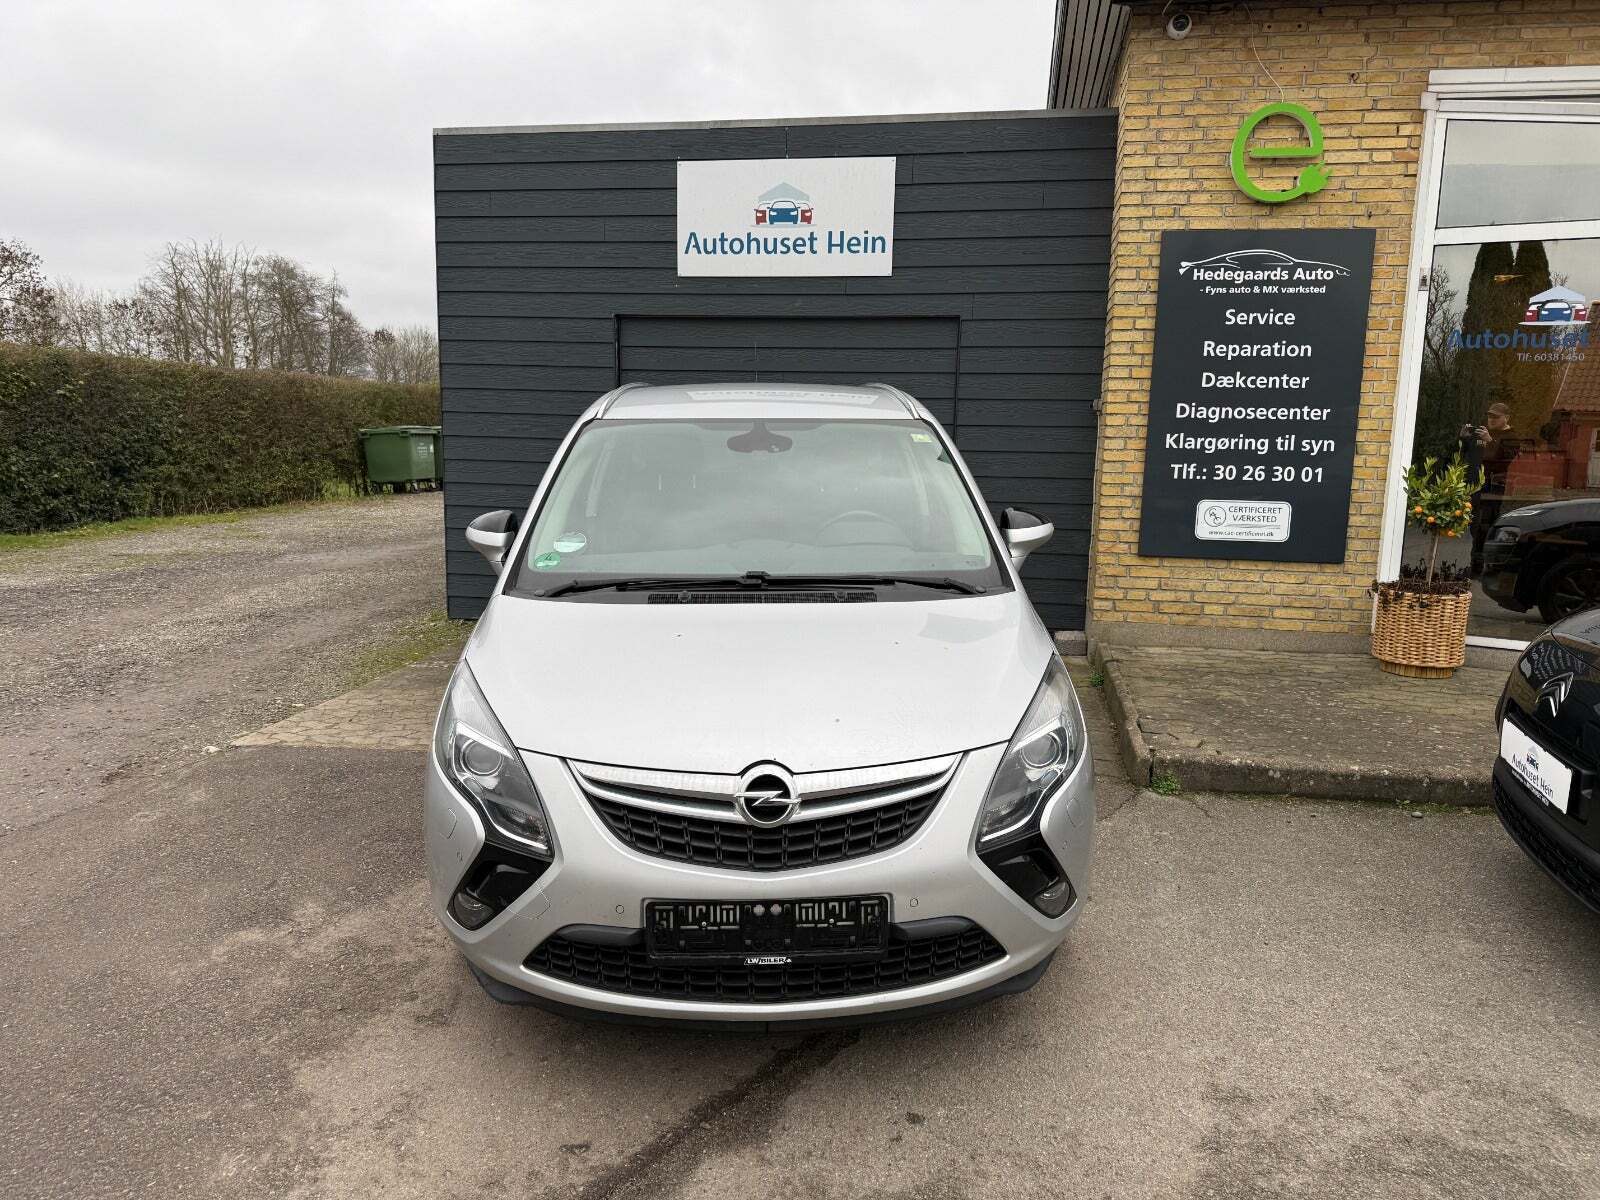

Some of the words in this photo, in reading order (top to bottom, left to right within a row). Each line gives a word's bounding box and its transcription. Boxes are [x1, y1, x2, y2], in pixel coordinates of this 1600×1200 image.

[684, 231, 818, 255] Autohuset
[827, 230, 886, 254] Hein
[1193, 267, 1289, 283] Hedegaards
[1293, 268, 1334, 281] Auto
[1205, 286, 1227, 295] Fyns
[1253, 286, 1261, 294] &
[1263, 286, 1279, 294] MX
[1281, 286, 1326, 294] værksted
[1225, 308, 1296, 326] Service
[1449, 327, 1591, 350] Autohuset
[1203, 340, 1312, 360] Reparation
[1201, 371, 1310, 389] Dækcenter
[1175, 403, 1331, 423] Diagnosecenter
[1165, 433, 1269, 455] Klargøring
[1276, 435, 1296, 451] til
[1301, 439, 1336, 456] syn
[1171, 463, 1207, 480] Tlf.:
[1213, 464, 1237, 481] 30
[1242, 465, 1266, 481] 26
[1271, 466, 1296, 482] 30
[1301, 467, 1323, 483] 01
[1228, 505, 1283, 514] CERTIFICERET
[1232, 514, 1277, 523] VÆRKSTED
